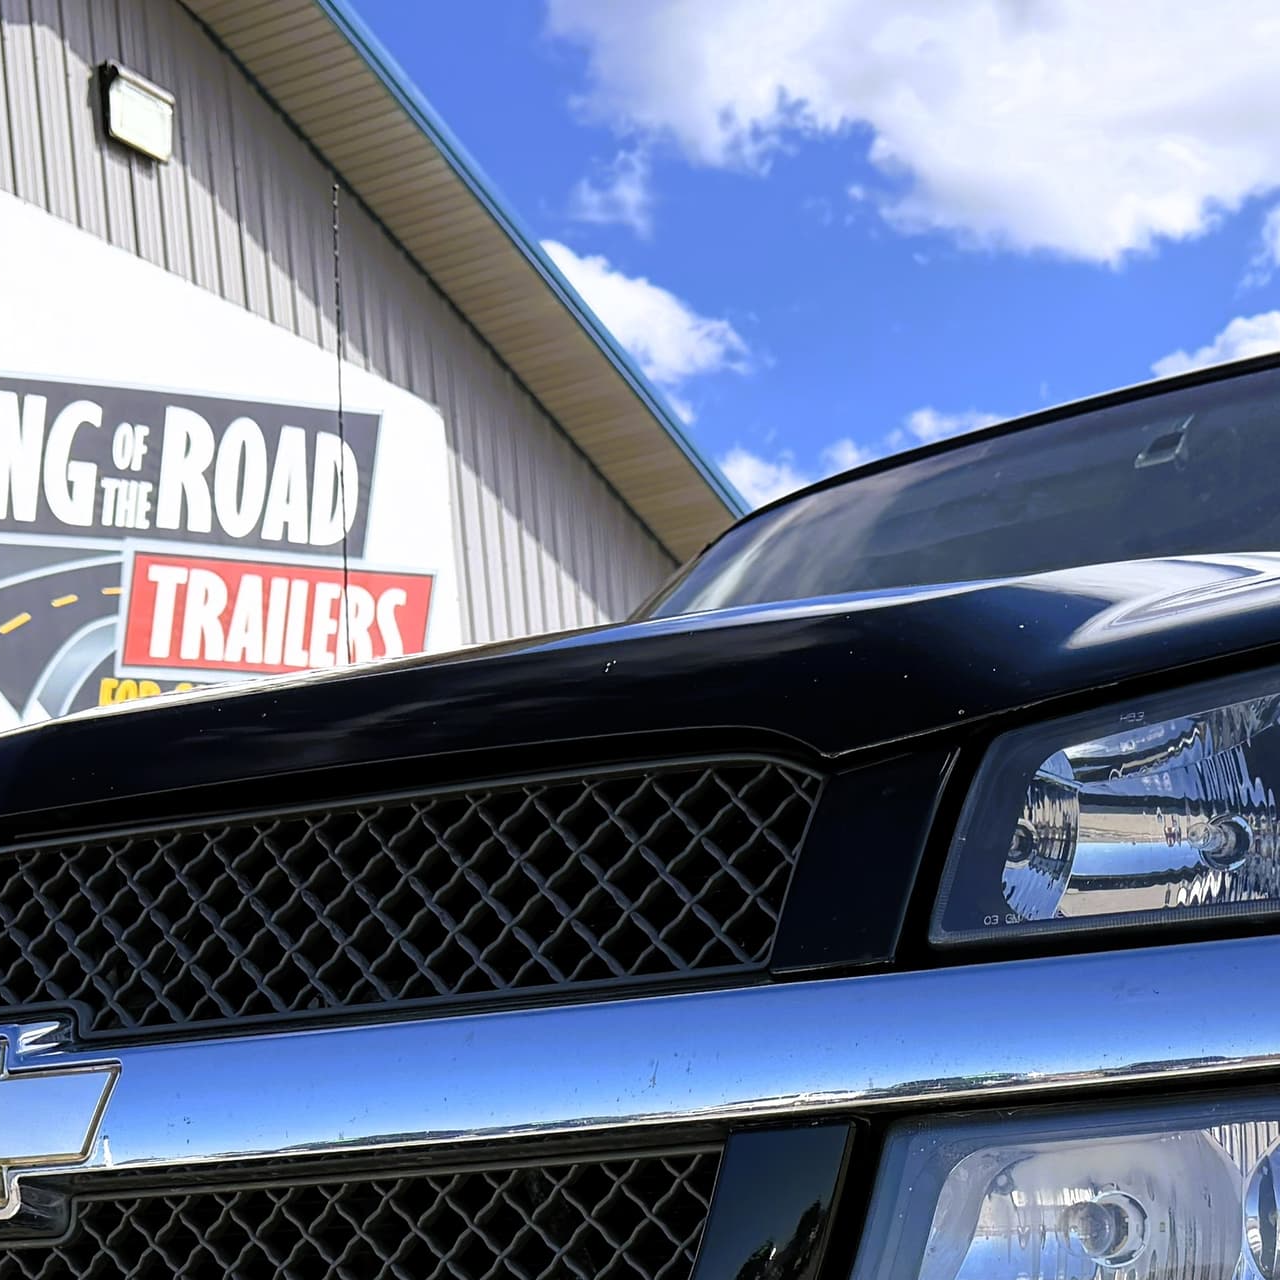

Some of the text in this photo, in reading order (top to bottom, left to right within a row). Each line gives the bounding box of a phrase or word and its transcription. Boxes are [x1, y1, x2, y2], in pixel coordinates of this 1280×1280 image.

[112, 422, 151, 472] OF
[155, 404, 360, 547] ROAD
[100, 476, 153, 530] THE
[147, 564, 408, 668] TRAILERS
